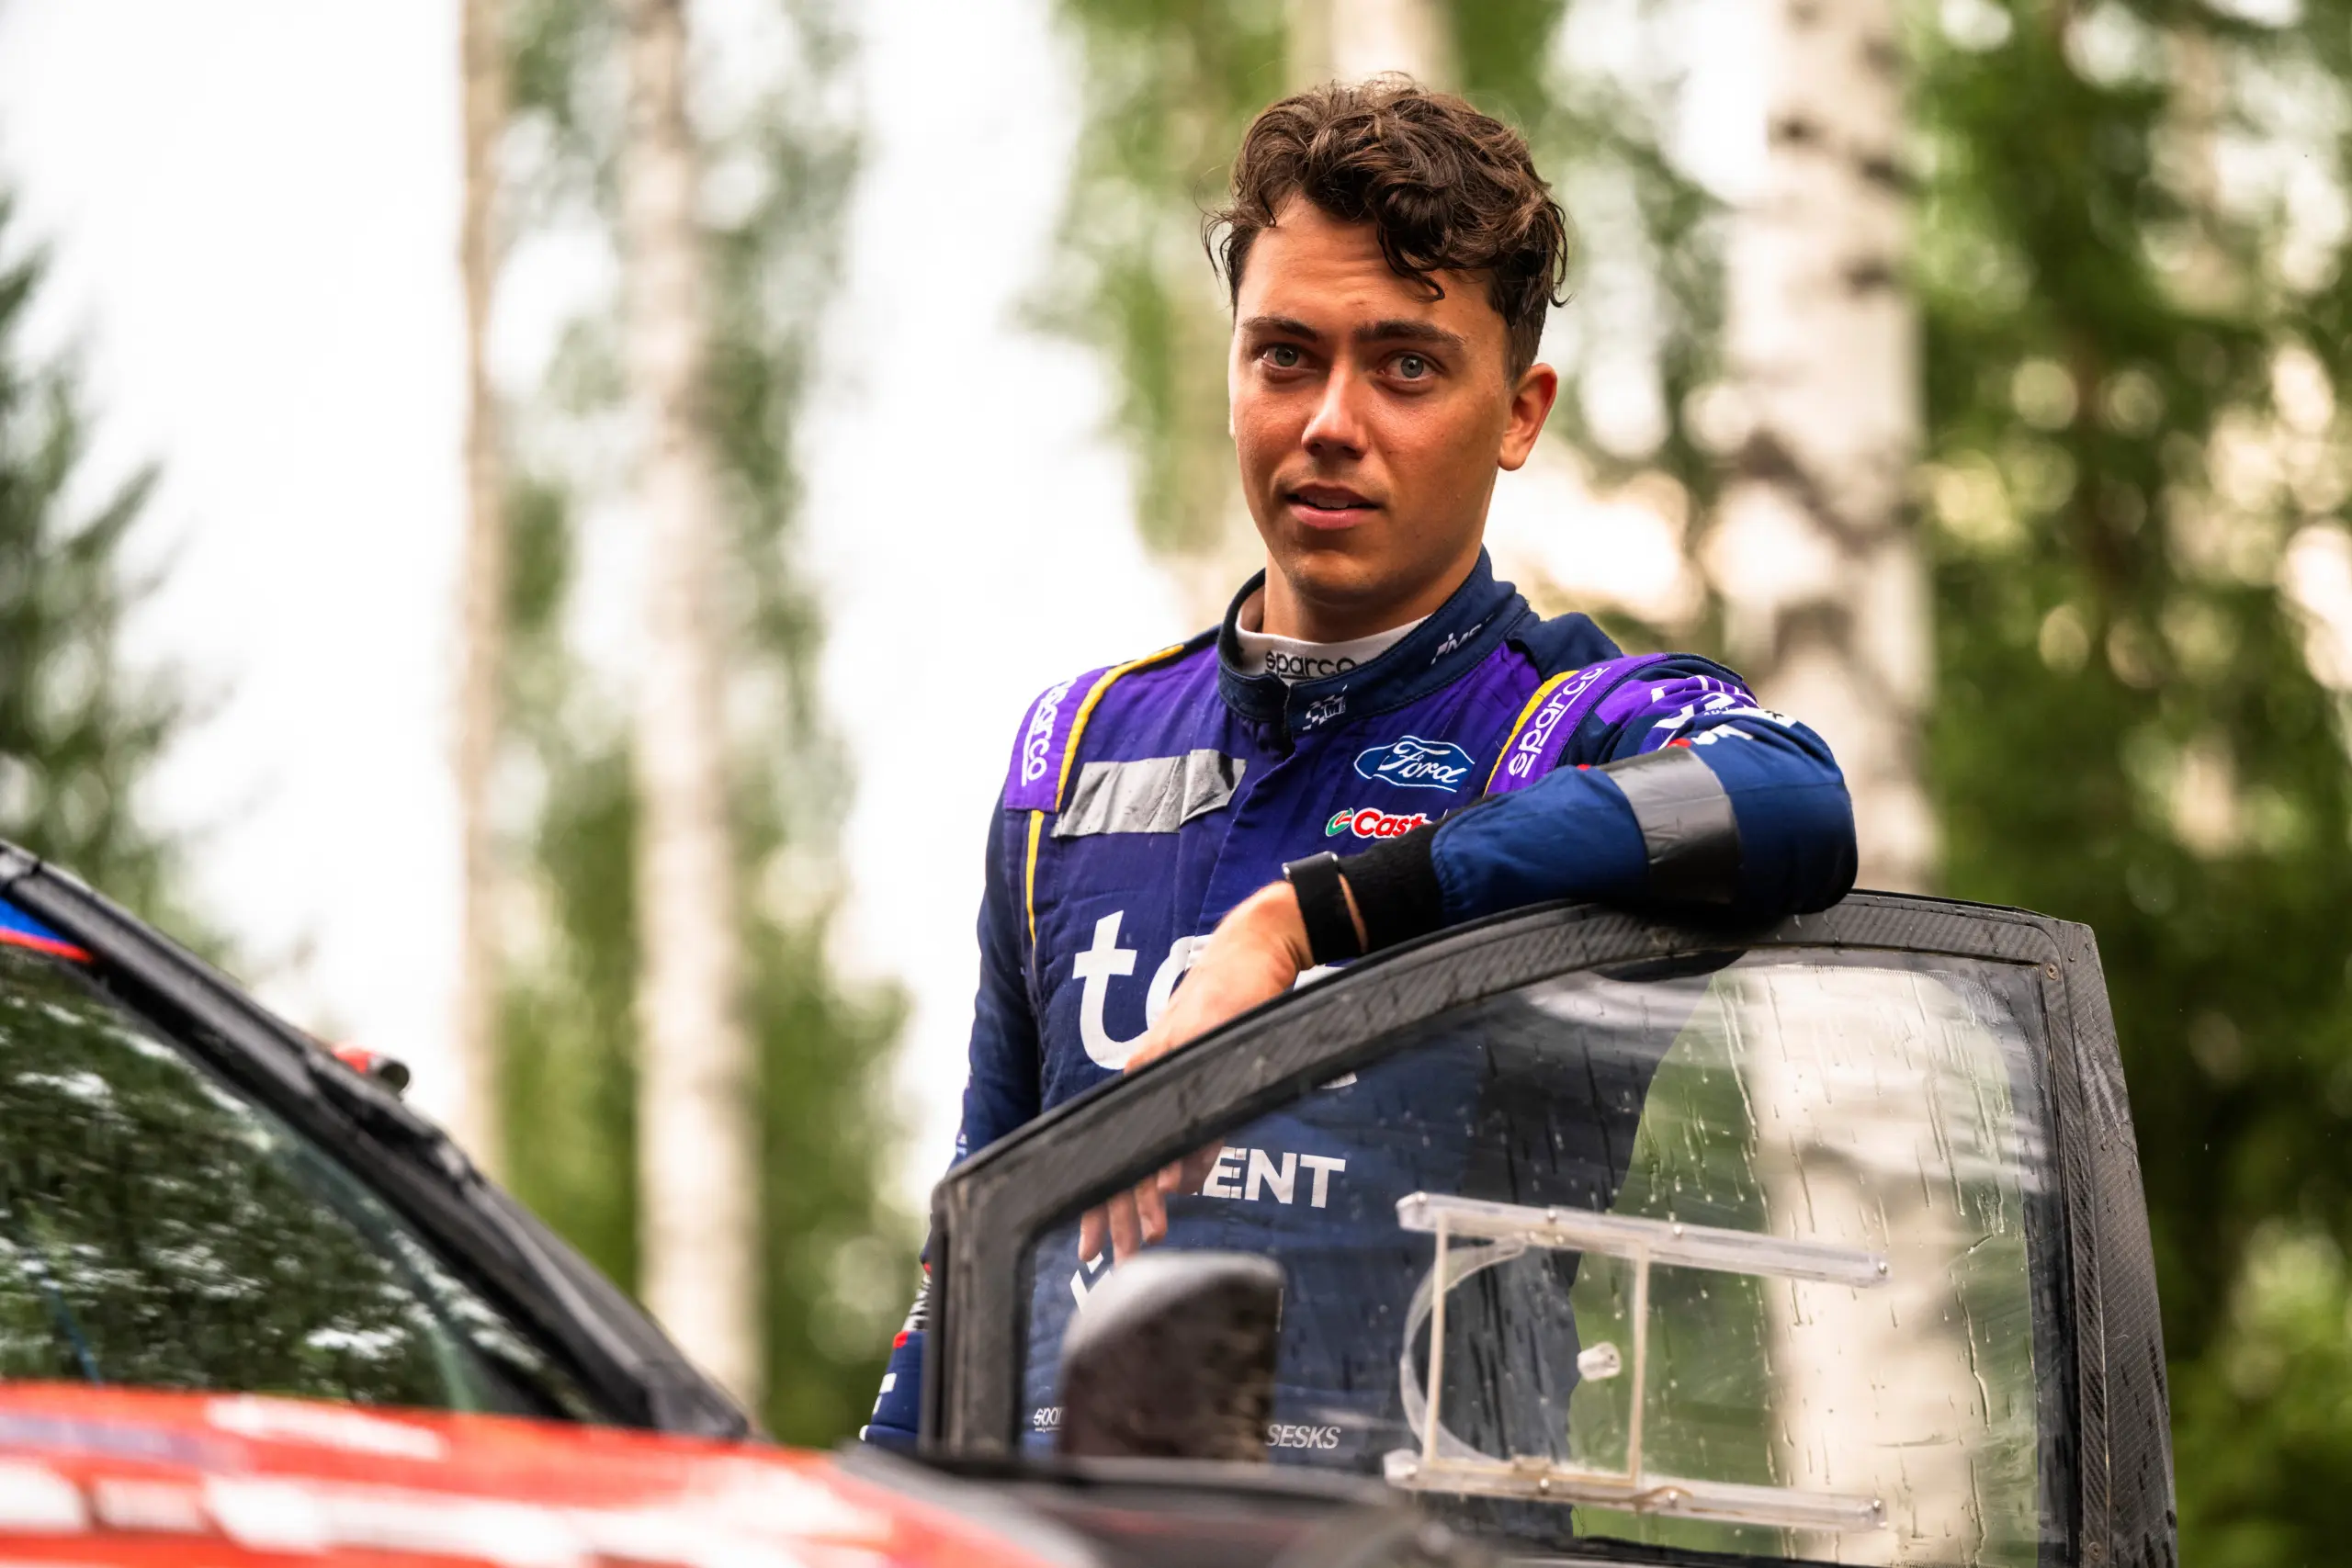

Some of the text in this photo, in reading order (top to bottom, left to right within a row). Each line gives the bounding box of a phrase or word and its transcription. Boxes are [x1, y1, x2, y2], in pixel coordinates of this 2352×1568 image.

[1266, 650, 1356, 678] sparco
[1509, 667, 1611, 778] sparco
[1377, 741, 1468, 783] Ford
[1353, 808, 1433, 837] Cast
[1192, 1145, 1347, 1209] ENT
[1265, 1424, 1341, 1449] SESKS
